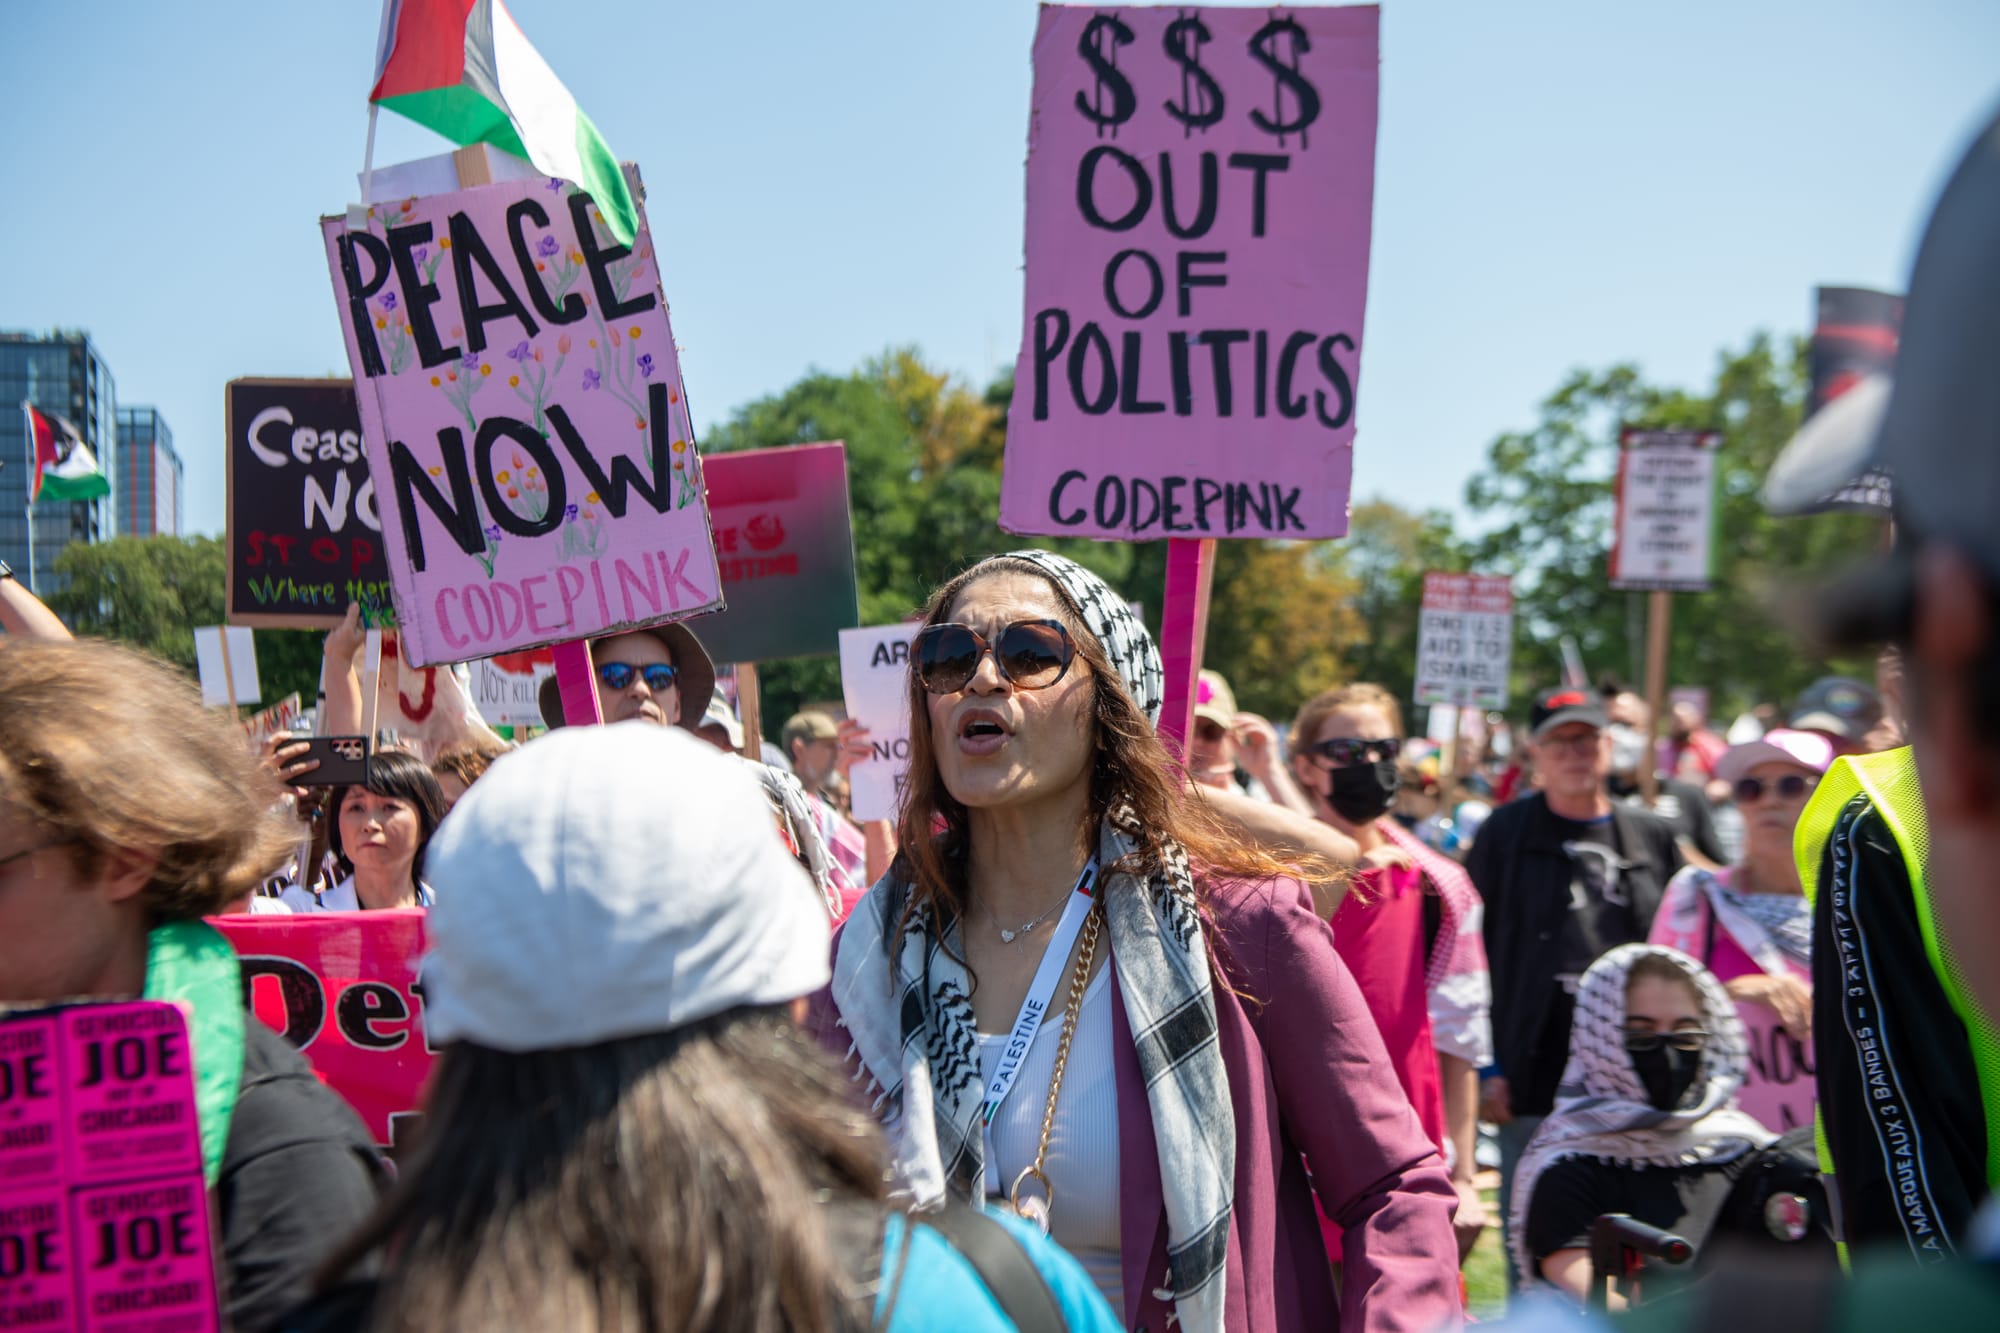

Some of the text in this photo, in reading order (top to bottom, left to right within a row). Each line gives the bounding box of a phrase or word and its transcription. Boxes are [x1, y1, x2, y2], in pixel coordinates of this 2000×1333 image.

[1076, 145, 1290, 240] OUT
[335, 194, 657, 377] PEACE
[1103, 248, 1228, 320] OF
[1032, 307, 1357, 430] POLITICS
[304, 467, 381, 533] NO
[387, 382, 672, 574] NOW
[1048, 470, 1307, 534] CODEPINK
[246, 529, 375, 577] STOP
[433, 547, 709, 651] CODEPINK
[479, 658, 507, 704] NOT
[870, 641, 910, 668] AR
[872, 737, 911, 762] NO
[239, 954, 443, 1055] De
[77, 1031, 183, 1089] JOE
[992, 999, 1044, 1093] PALESTINE
[1856, 1026, 1893, 1100] BANDES
[1880, 1105, 1898, 1116] 3
[1887, 1120, 1912, 1157] AUX
[1897, 1159, 1934, 1235] MARQUE
[92, 1211, 197, 1269] JOE
